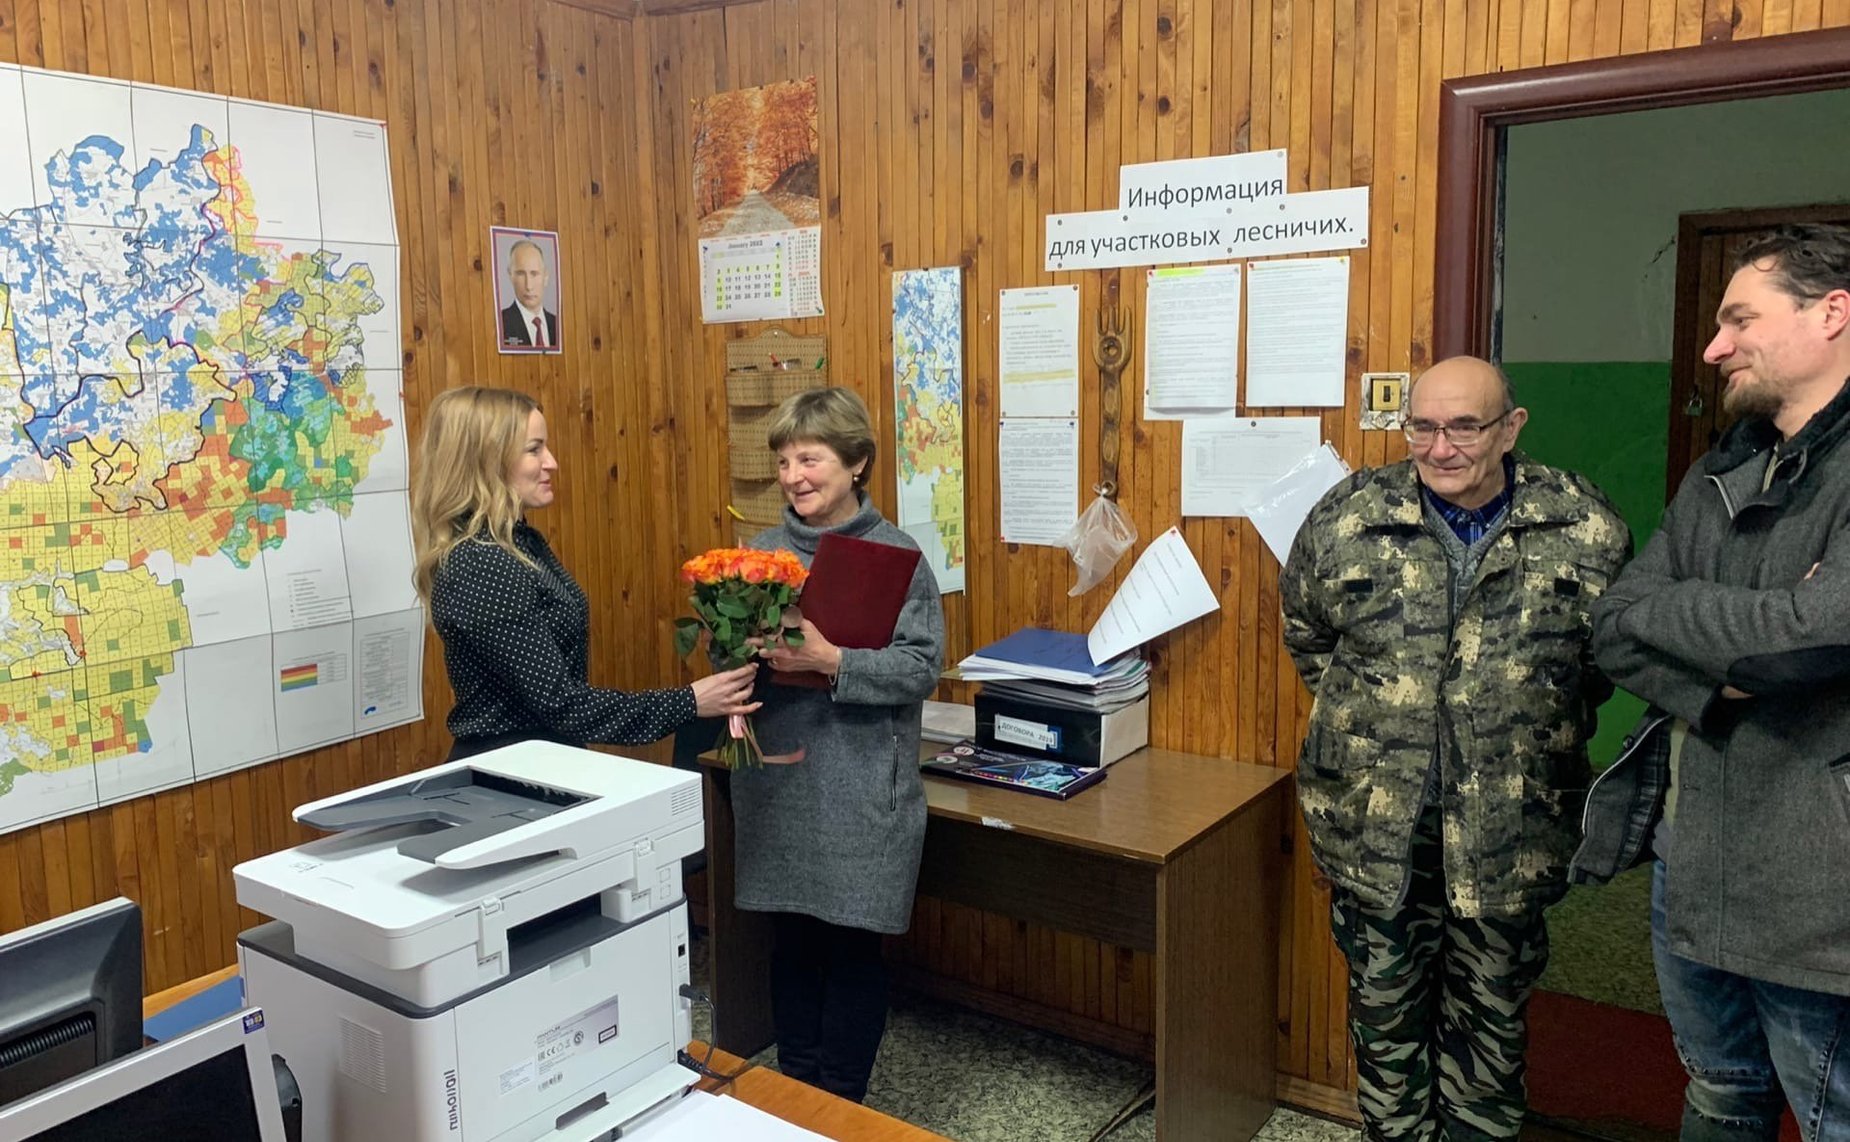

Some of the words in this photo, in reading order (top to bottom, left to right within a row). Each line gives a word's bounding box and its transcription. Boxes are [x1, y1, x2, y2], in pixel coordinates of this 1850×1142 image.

[1128, 179, 1283, 210] Информация
[1048, 239, 1086, 260] для
[1091, 229, 1221, 258] участковых
[1233, 216, 1354, 243] лесничих.
